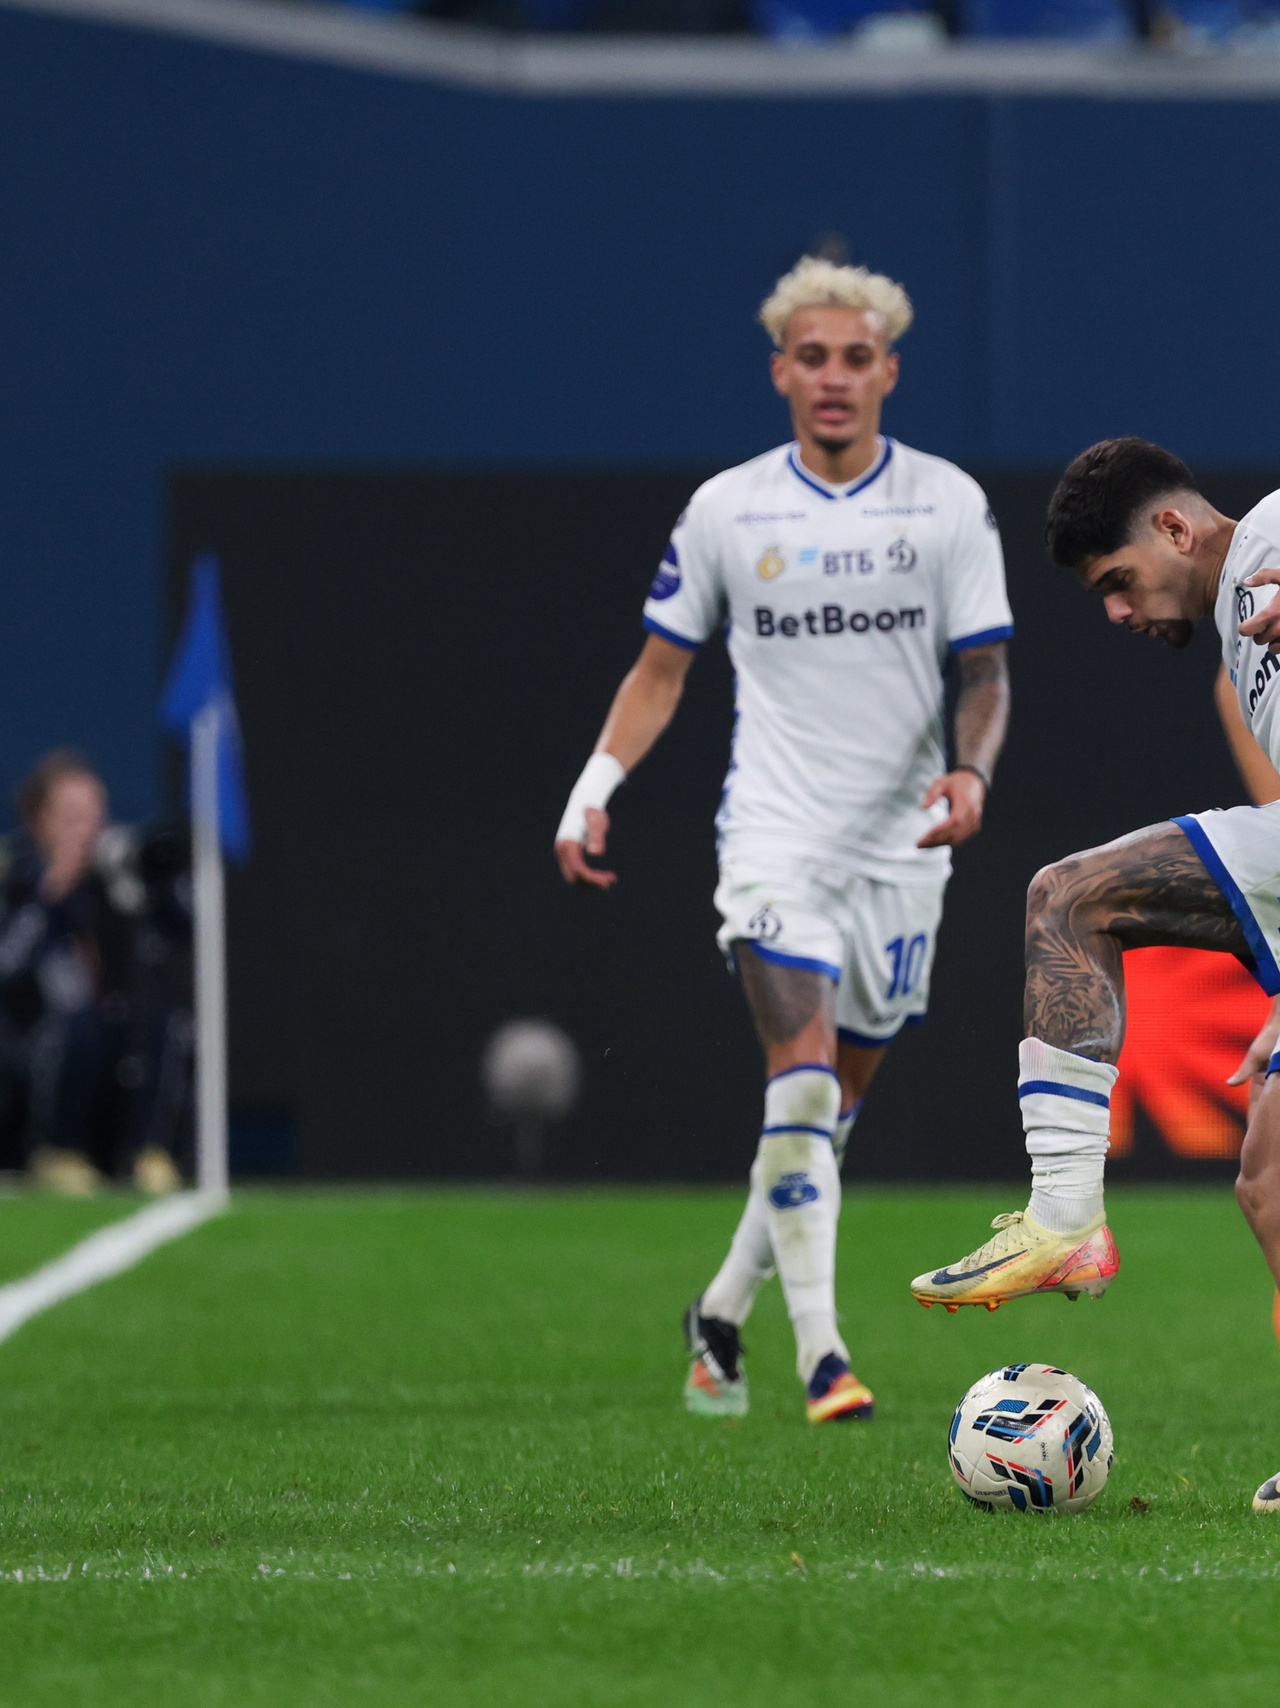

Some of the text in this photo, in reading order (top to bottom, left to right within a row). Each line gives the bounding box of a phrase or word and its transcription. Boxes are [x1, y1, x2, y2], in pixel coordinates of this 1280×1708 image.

[822, 551, 875, 577] ВТБ
[754, 604, 927, 638] BetBoom
[885, 932, 927, 1000] 10
